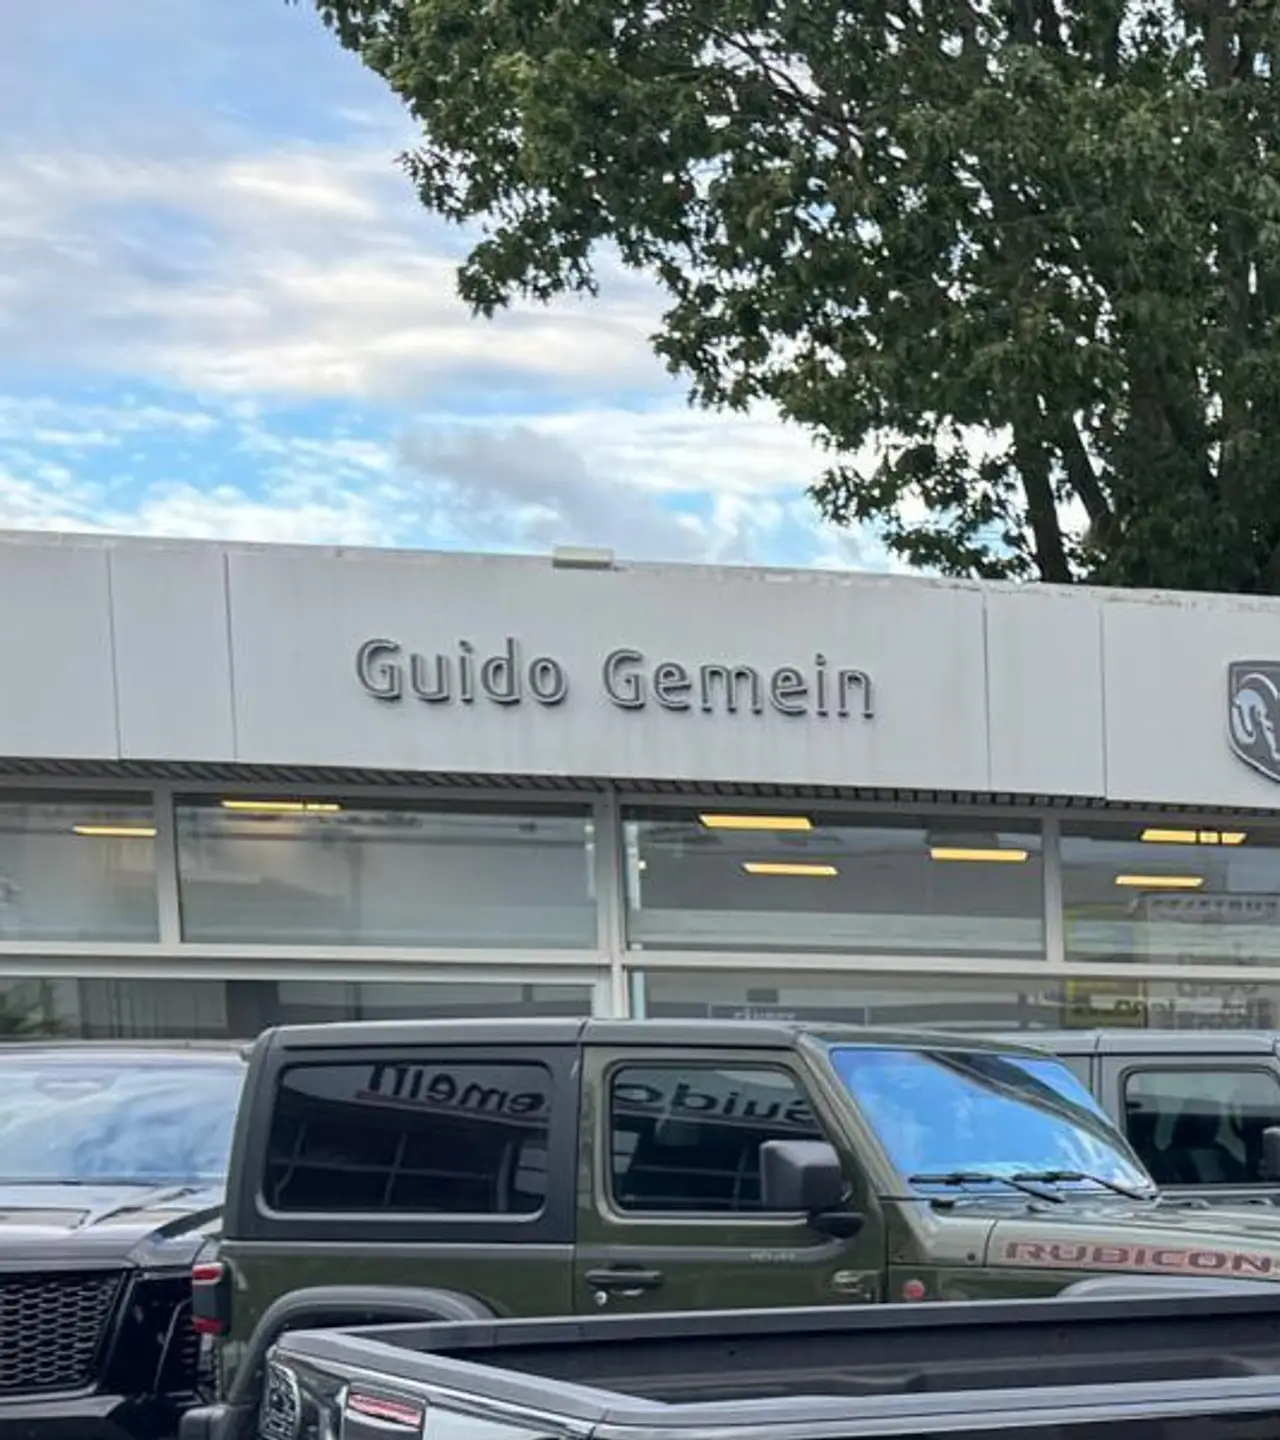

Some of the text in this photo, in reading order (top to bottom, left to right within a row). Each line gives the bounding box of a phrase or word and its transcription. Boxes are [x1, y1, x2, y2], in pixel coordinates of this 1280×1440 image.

[357, 637, 875, 718] Guido Gemein
[1005, 1241, 1273, 1274] RUBICON
